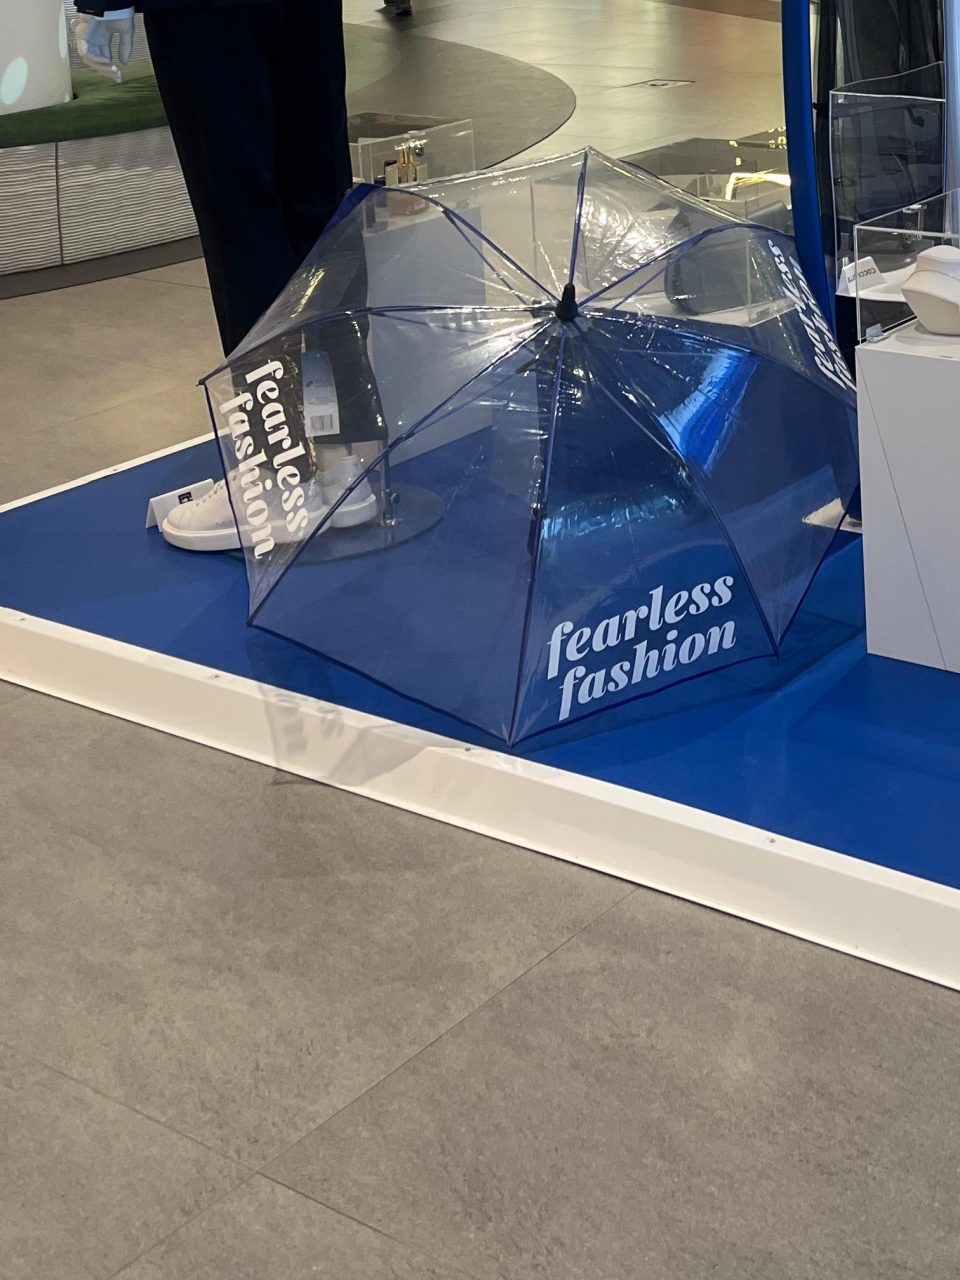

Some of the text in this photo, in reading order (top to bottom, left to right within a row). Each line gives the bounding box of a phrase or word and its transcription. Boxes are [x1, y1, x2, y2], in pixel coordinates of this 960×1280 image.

[767, 239, 848, 391] fearless
[218, 390, 275, 560] fashion
[244, 359, 309, 533] fearless
[546, 575, 735, 681] fearless
[558, 620, 737, 722] fashion
